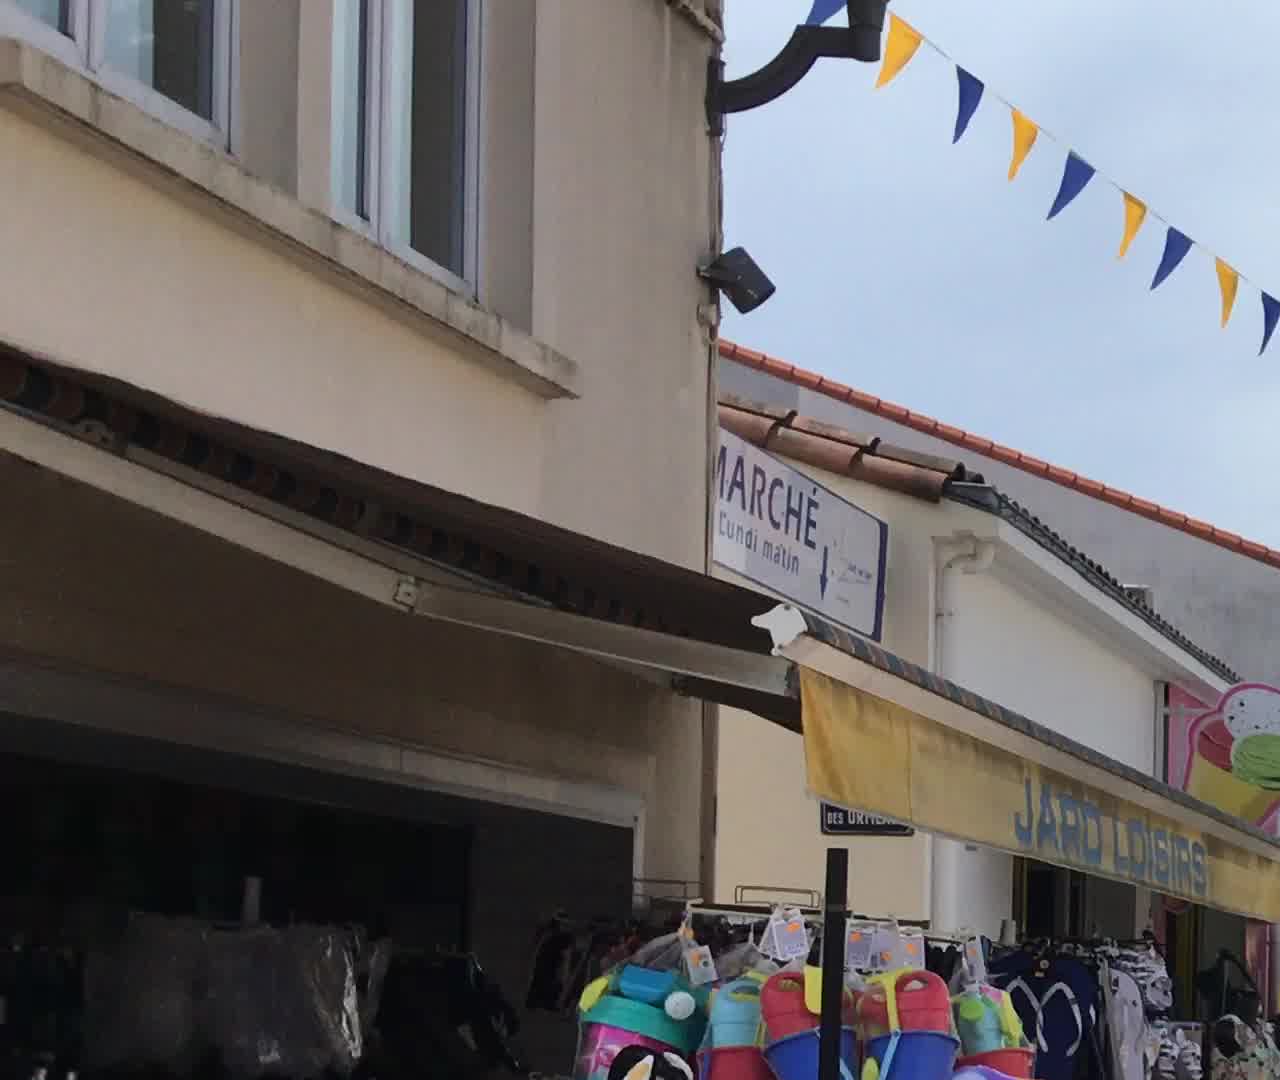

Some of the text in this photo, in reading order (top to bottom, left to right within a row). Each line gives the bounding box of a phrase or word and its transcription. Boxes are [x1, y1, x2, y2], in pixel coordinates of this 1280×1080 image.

[719, 509, 758, 553] Lundi
[762, 539, 800, 576] matin
[1013, 775, 1209, 898] JARD LOISIRS
